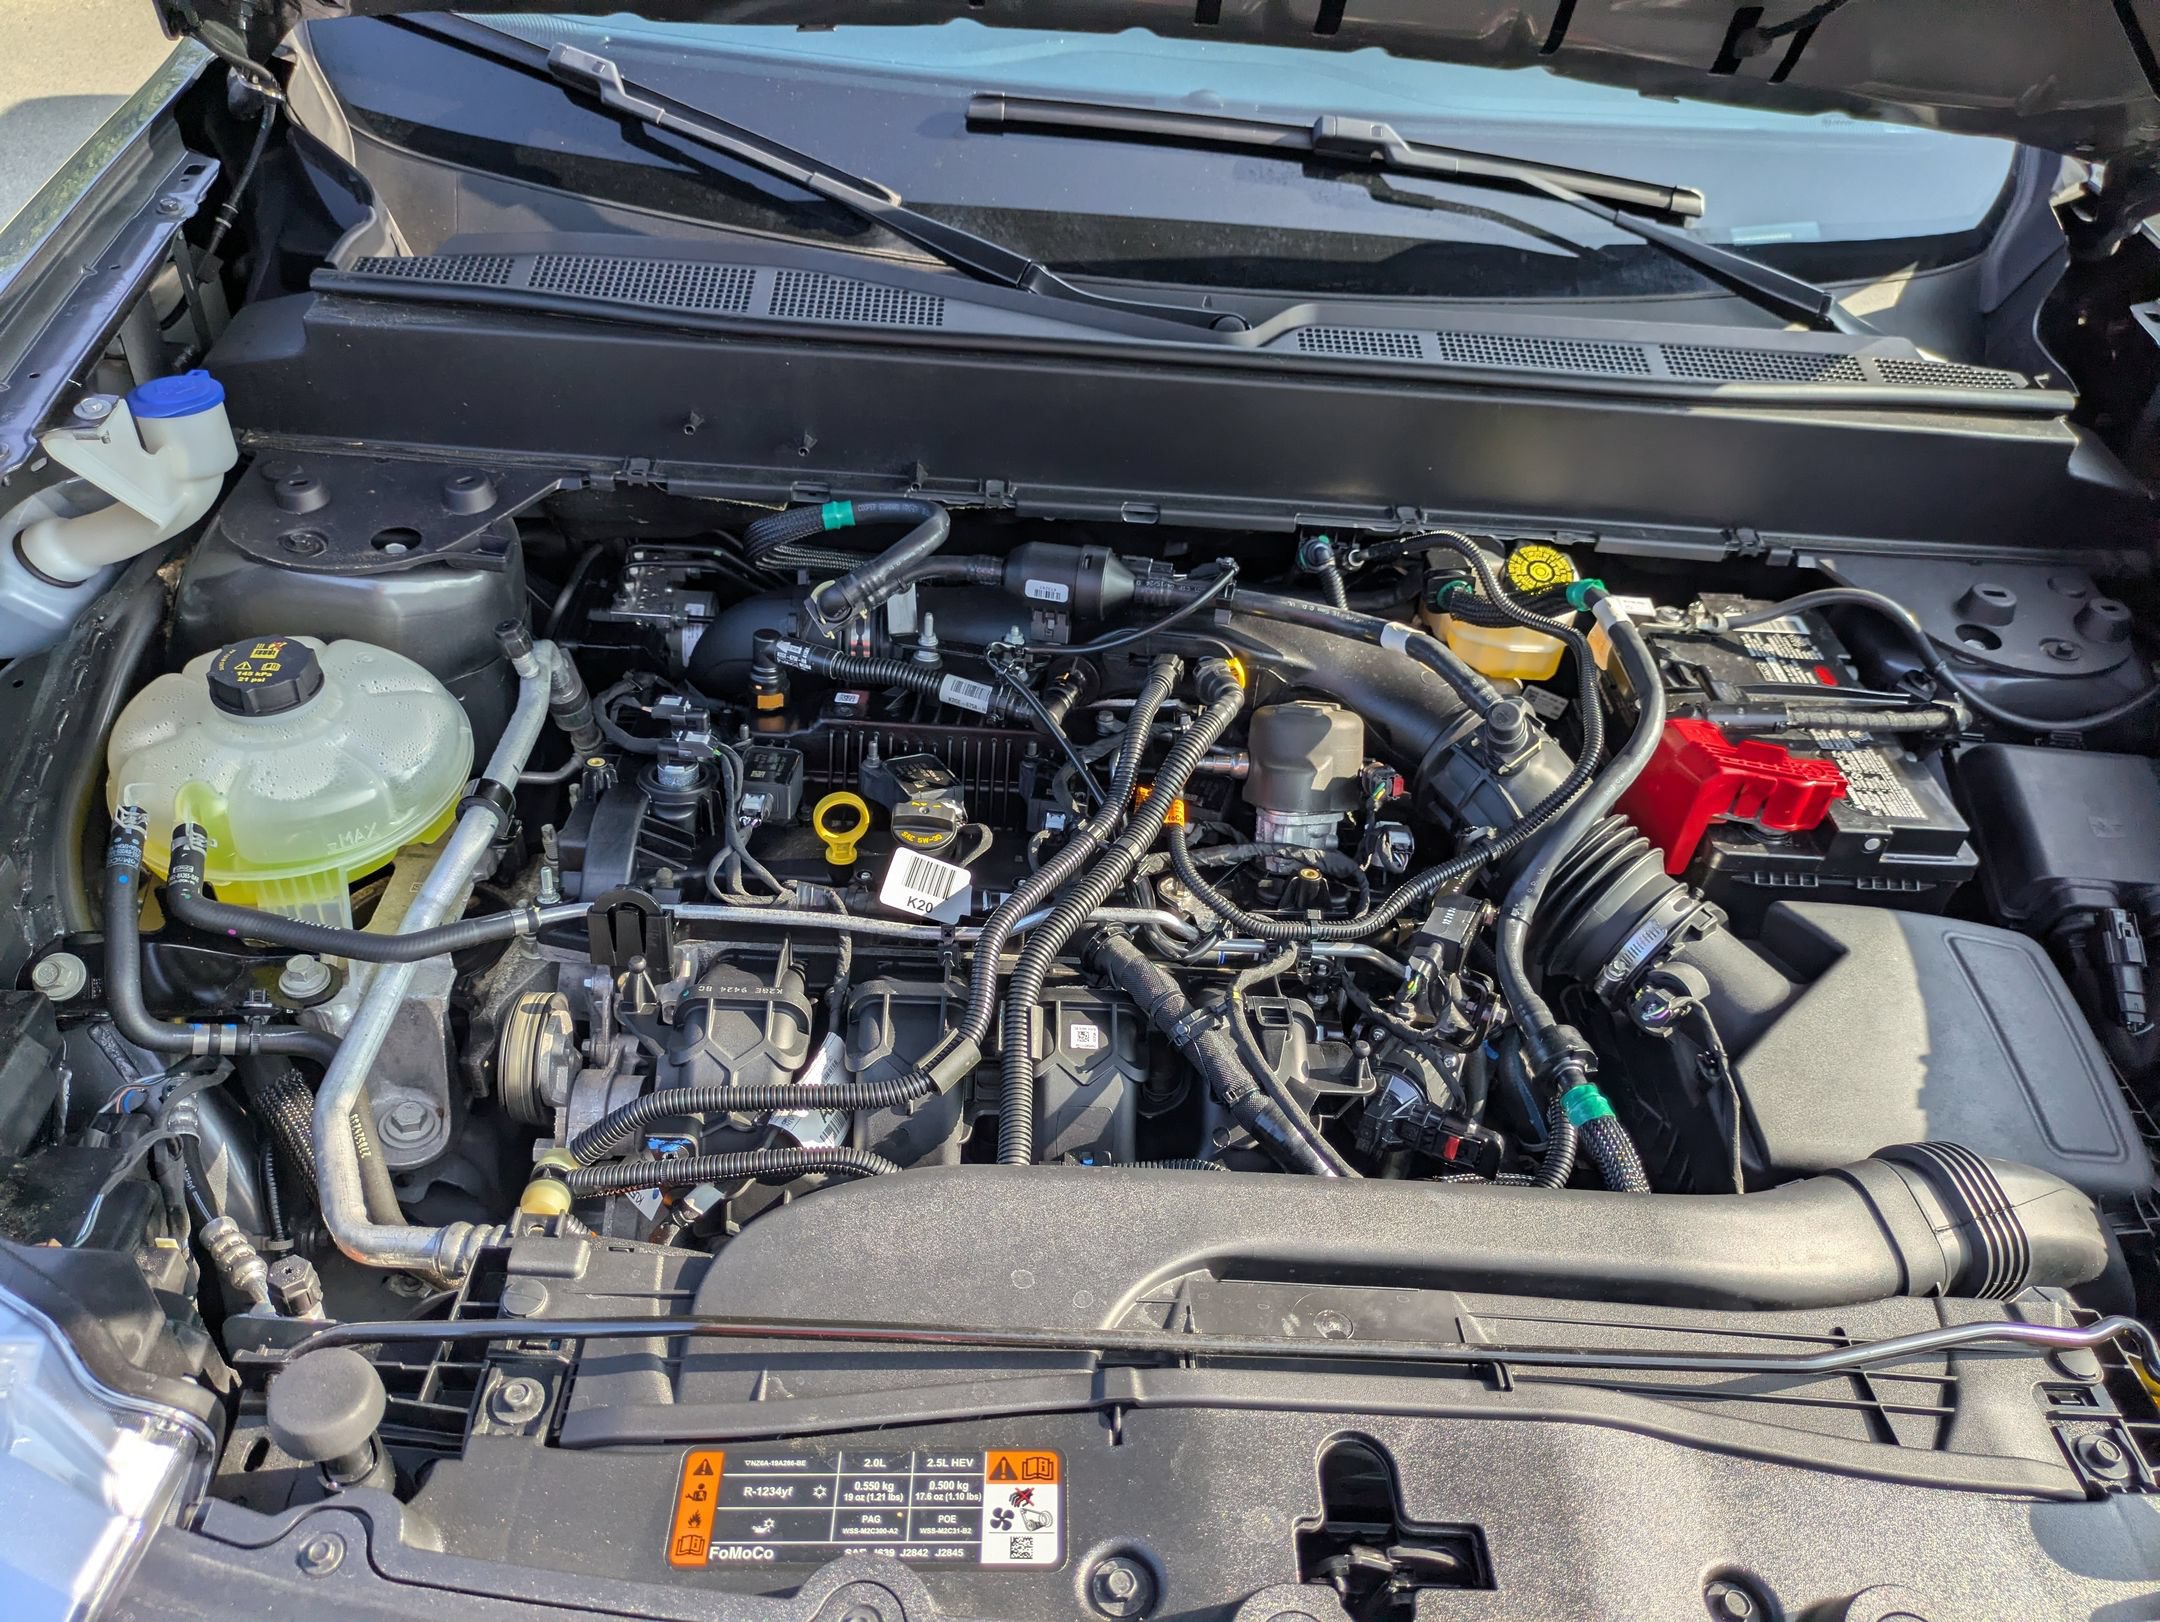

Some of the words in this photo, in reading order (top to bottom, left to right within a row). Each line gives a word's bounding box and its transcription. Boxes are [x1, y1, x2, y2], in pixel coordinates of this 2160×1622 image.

[338, 821, 377, 849] MAX
[901, 831, 916, 842] SAE
[917, 833, 943, 844] 5W-30
[906, 895, 934, 914] K20
[863, 1458, 886, 1467] 2.0L
[926, 1458, 949, 1467] 2.5L
[951, 1458, 974, 1467] HEV
[854, 1481, 880, 1491] 0.550
[882, 1481, 895, 1493] kg
[929, 1480, 955, 1490] 0.500
[956, 1480, 970, 1493] kg
[743, 1486, 794, 1499] R-1234yf
[843, 1493, 854, 1501] 19
[867, 1492, 886, 1503] (1.21
[887, 1492, 904, 1503] lbs)
[915, 1492, 932, 1501] 17.6
[945, 1492, 965, 1502] (1.10
[966, 1492, 982, 1502] lbs)
[861, 1515, 881, 1523] PAG
[938, 1515, 957, 1523] POE
[709, 1546, 774, 1560] FoMoCo
[899, 1548, 929, 1557] J2842
[934, 1548, 964, 1557] J2845
